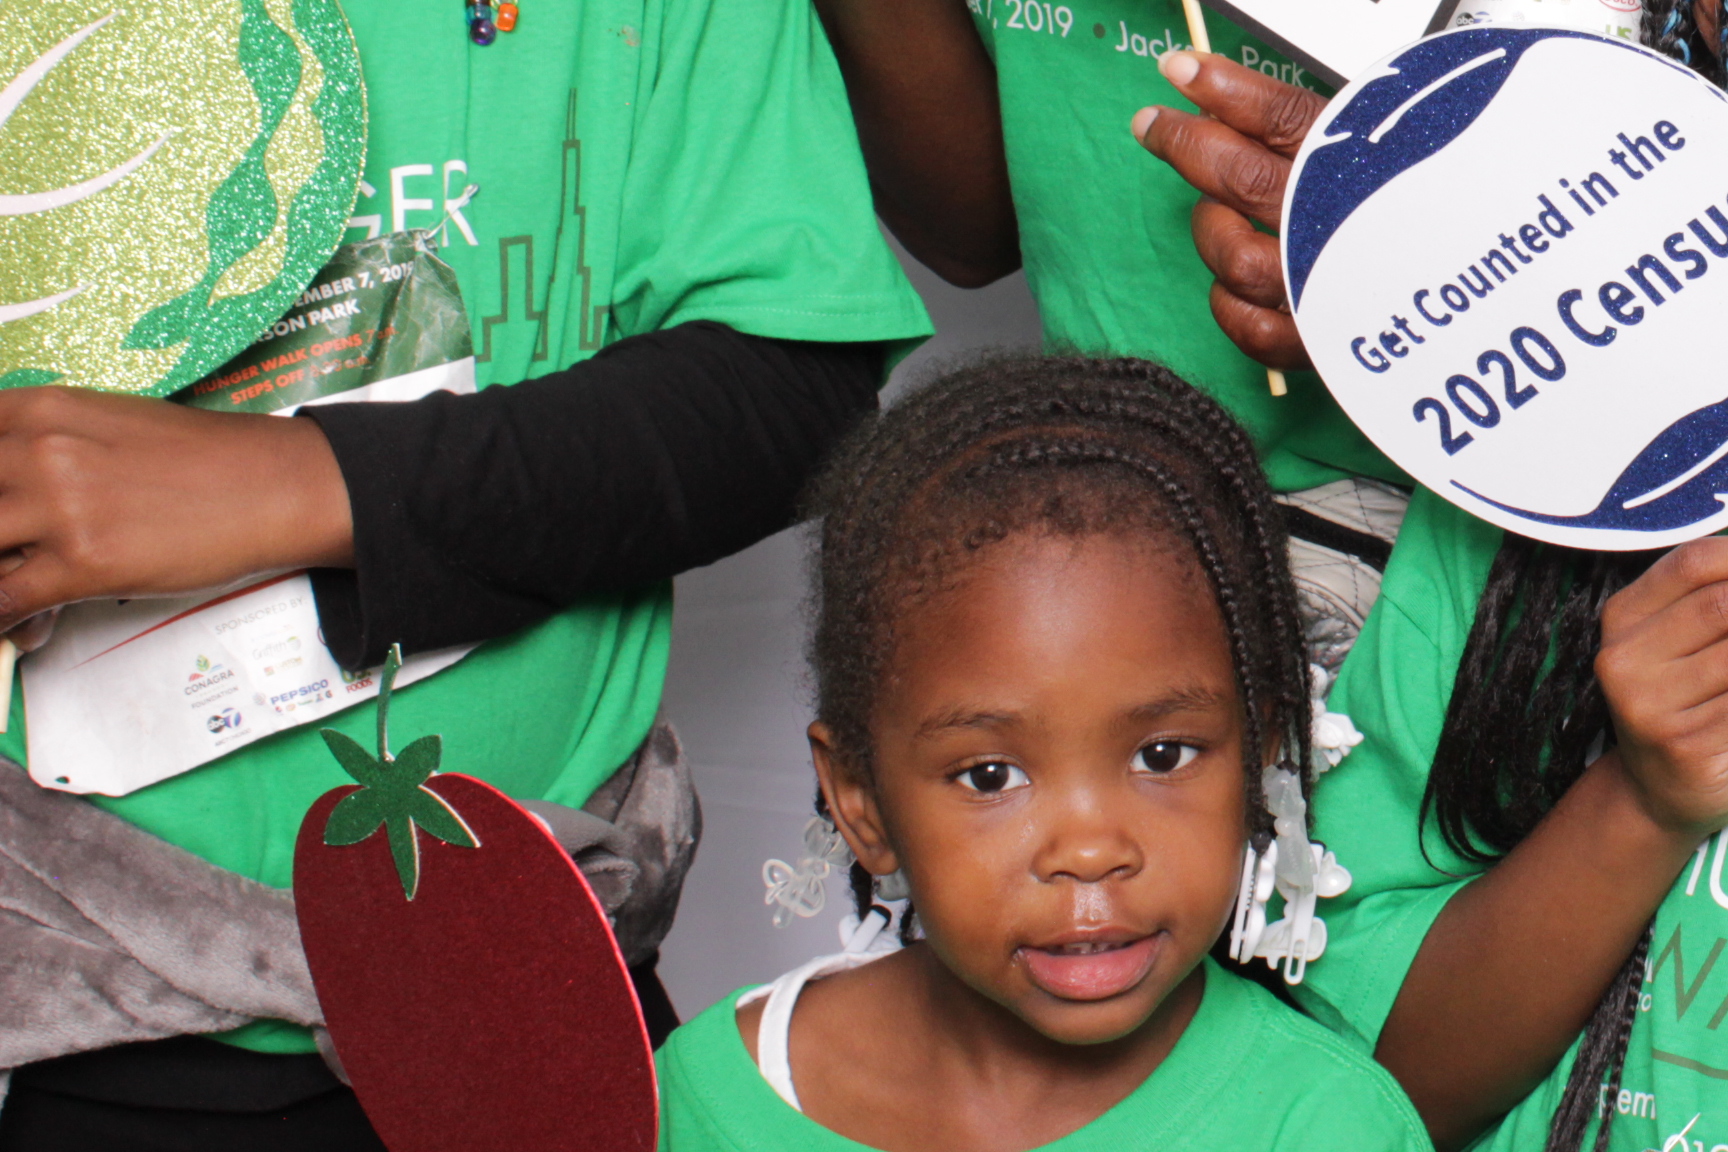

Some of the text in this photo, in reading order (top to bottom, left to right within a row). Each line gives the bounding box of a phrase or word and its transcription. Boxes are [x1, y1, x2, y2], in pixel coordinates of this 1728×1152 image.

[1350, 119, 1686, 375] Get Counted in the
[294, 275, 357, 308] EMBER
[357, 271, 376, 290] 7,
[307, 298, 362, 327] PARK
[193, 364, 260, 396] HUNGER
[260, 347, 309, 373] WALK
[309, 332, 363, 358] OPENS
[230, 382, 274, 406] STEPS
[275, 367, 305, 389] OFF
[1412, 325, 1567, 457] 2020
[214, 602, 288, 636] SPONSORED
[184, 669, 236, 696] CONAGRA
[269, 678, 330, 705] PEPSICO
[345, 677, 374, 694] FOODS
